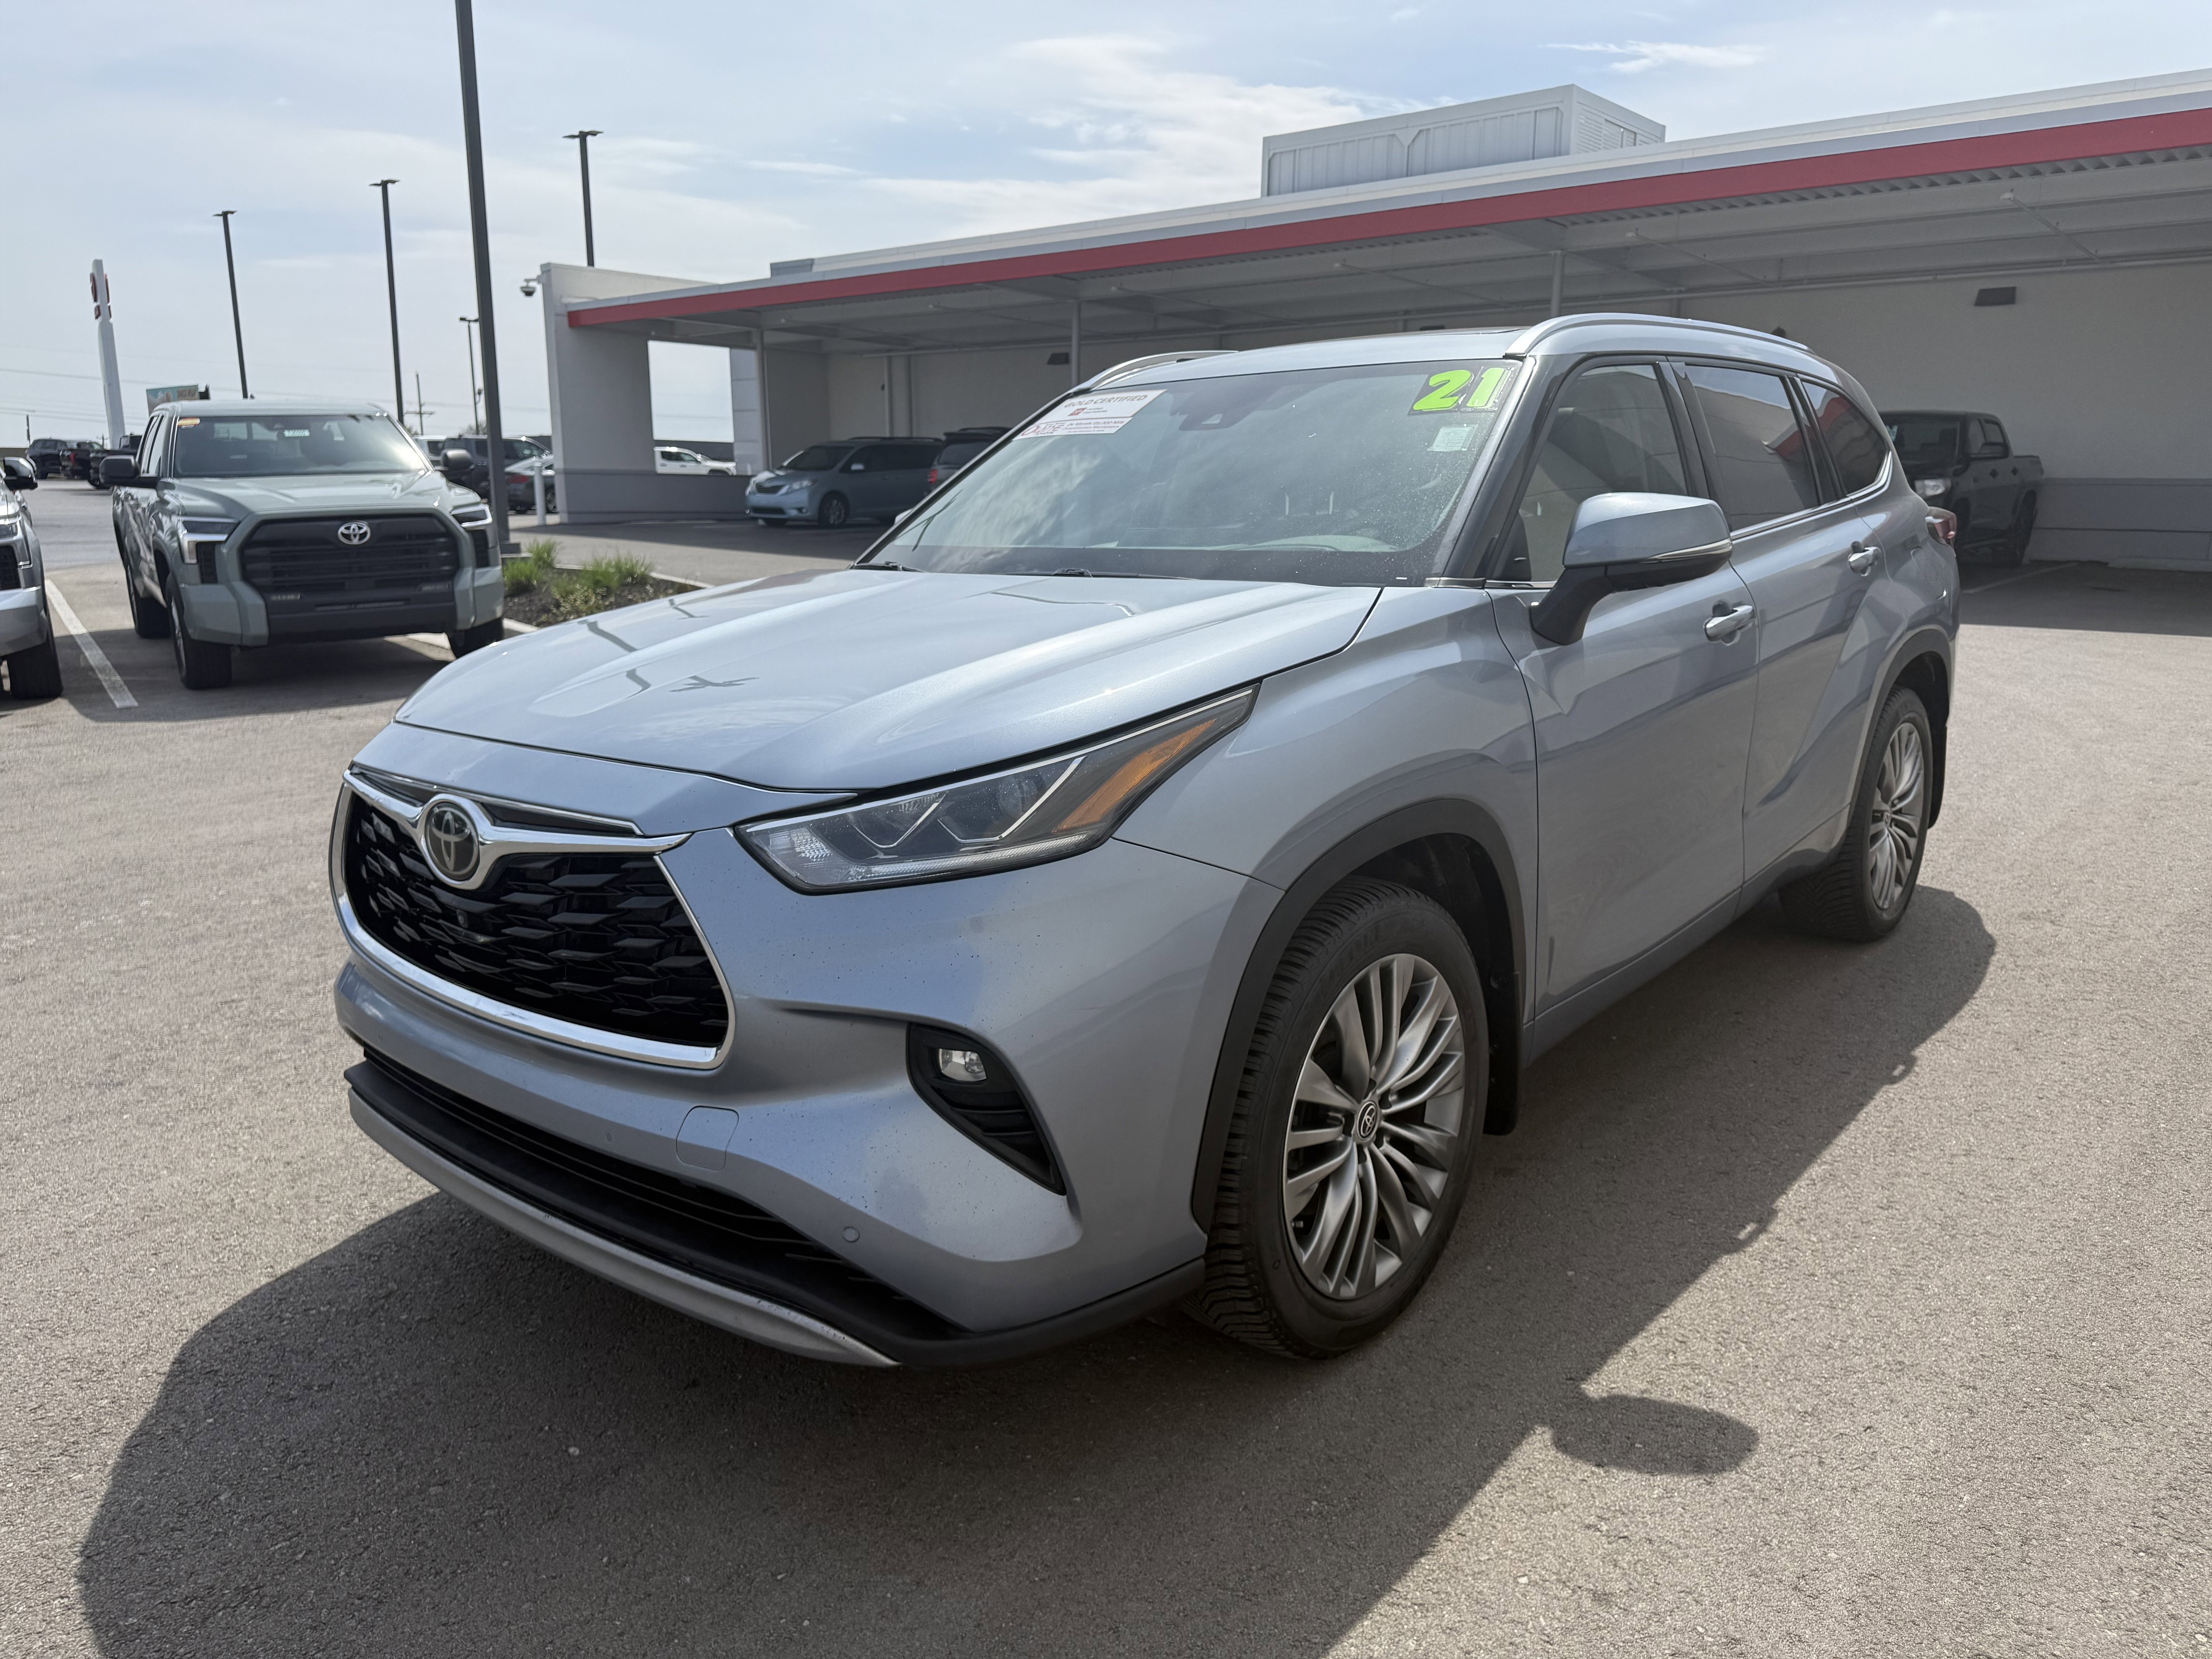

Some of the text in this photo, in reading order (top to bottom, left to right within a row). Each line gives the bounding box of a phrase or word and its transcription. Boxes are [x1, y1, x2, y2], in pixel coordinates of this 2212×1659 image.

[1065, 395, 1148, 407] GOLD CERTIFIED
[1413, 368, 1506, 411] 21
